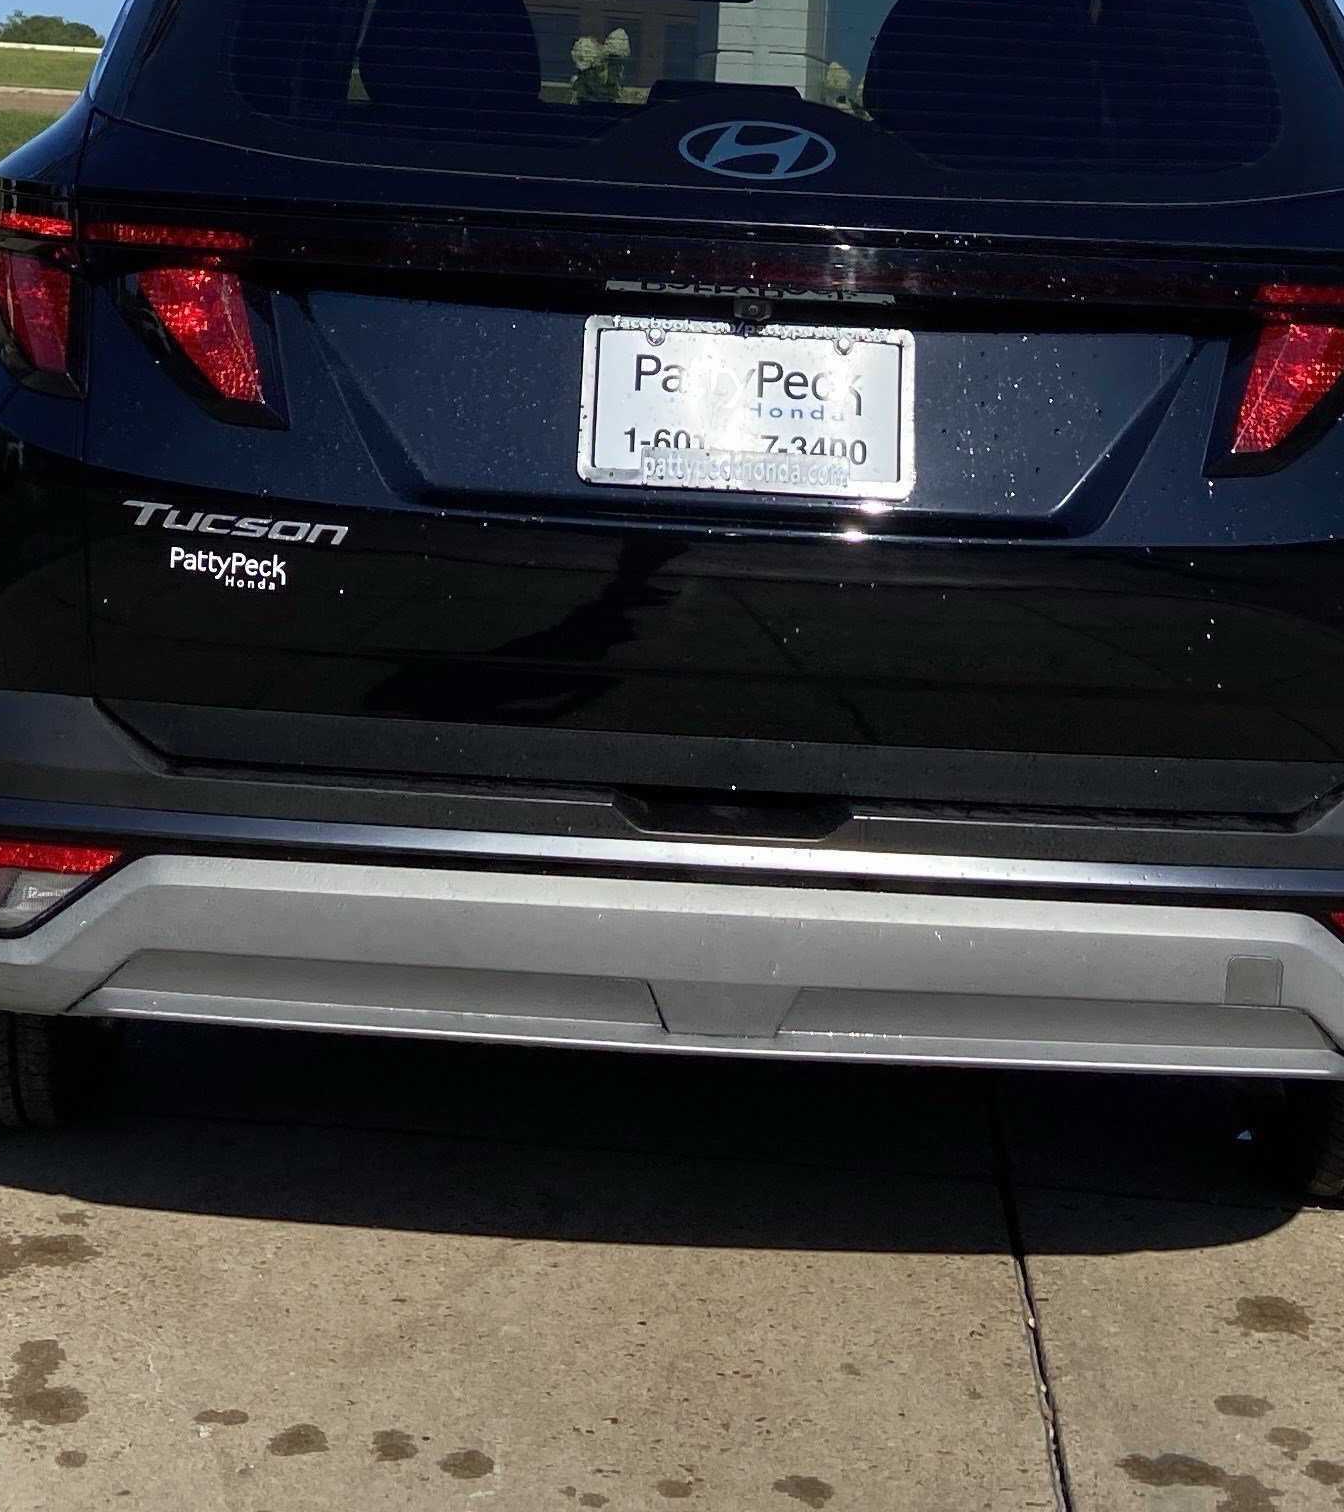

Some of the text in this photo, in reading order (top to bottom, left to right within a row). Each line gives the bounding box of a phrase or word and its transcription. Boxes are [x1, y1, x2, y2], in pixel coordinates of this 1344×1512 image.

[634, 353, 862, 417] PatyPeck
[643, 451, 848, 486] pattypeckhonda.com
[169, 546, 287, 586] PattyPeck
[224, 576, 276, 590] Honda
